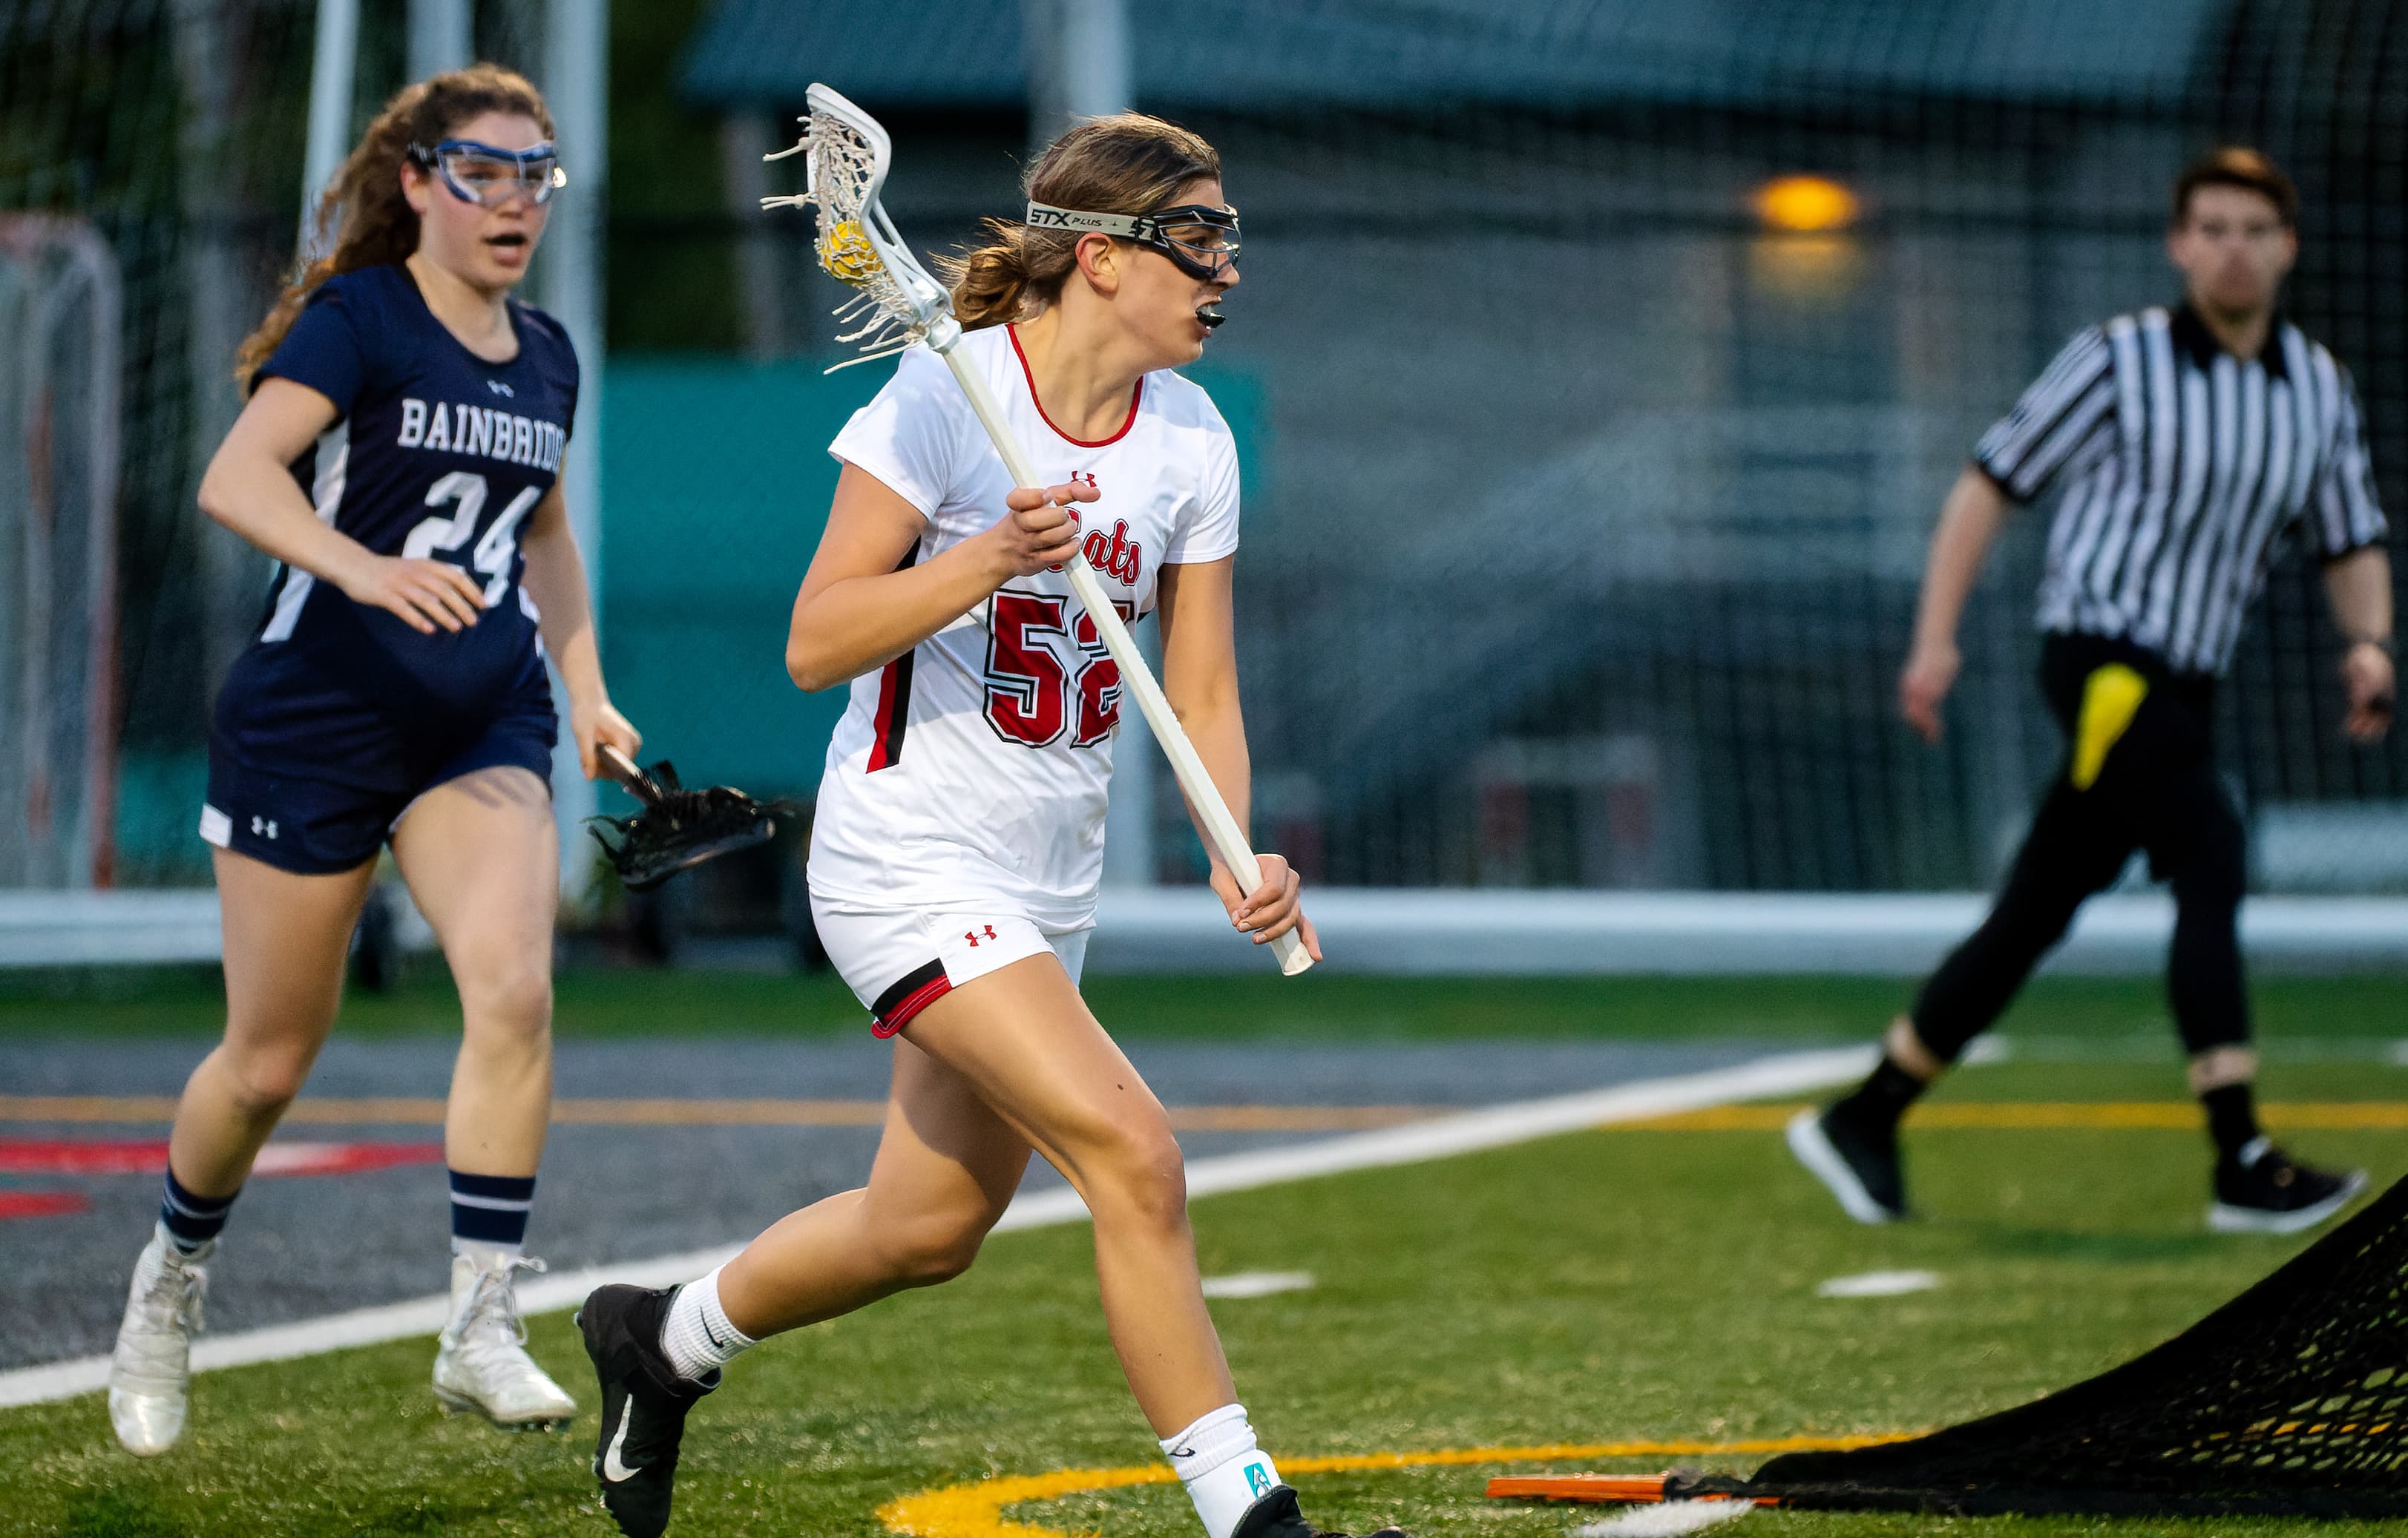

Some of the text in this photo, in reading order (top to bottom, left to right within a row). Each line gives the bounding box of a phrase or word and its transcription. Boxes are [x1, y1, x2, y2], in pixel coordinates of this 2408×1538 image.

[1030, 209, 1102, 226] STX PLUS
[401, 471, 541, 608] 24
[1047, 507, 1141, 586] ats
[982, 588, 1134, 749] 52
